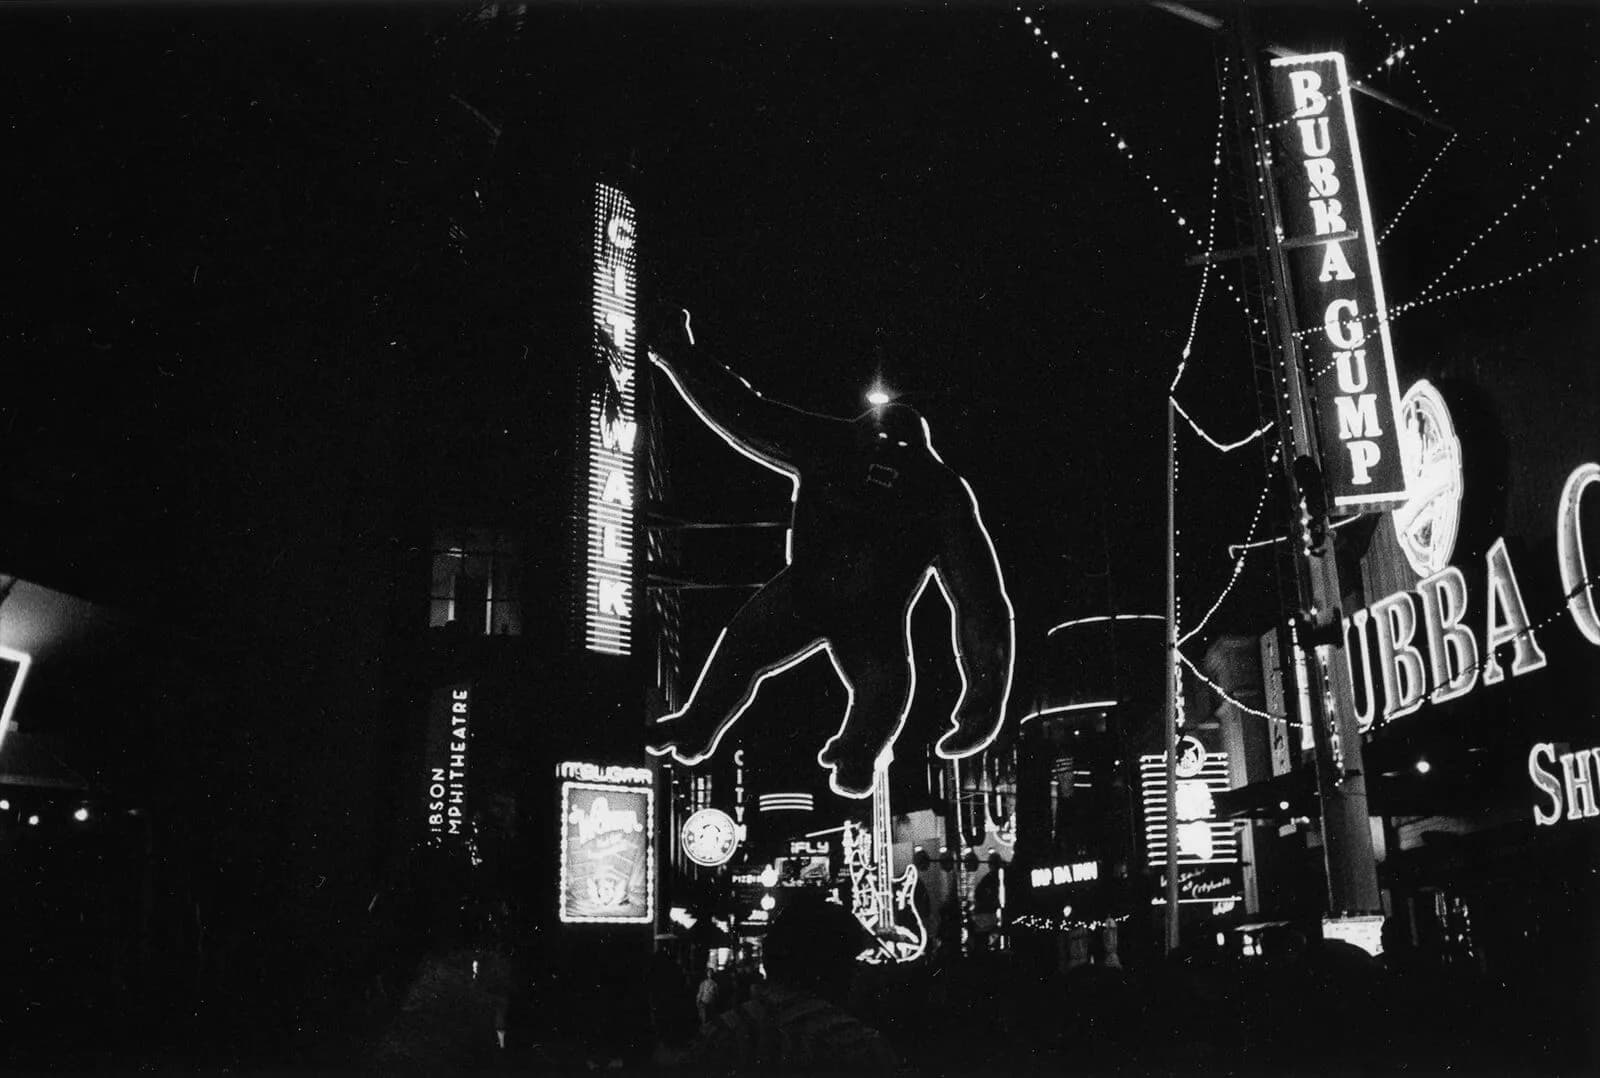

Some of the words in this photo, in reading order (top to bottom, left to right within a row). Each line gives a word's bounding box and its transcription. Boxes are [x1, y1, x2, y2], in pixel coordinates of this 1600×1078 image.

[1289, 70, 1356, 282] BUBBA
[1324, 298, 1382, 485] GUMP
[600, 217, 637, 618] CITYWALK
[428, 768, 445, 836] IBSON
[447, 689, 468, 835] MPHITHEATRE
[1528, 742, 1600, 826] SH
